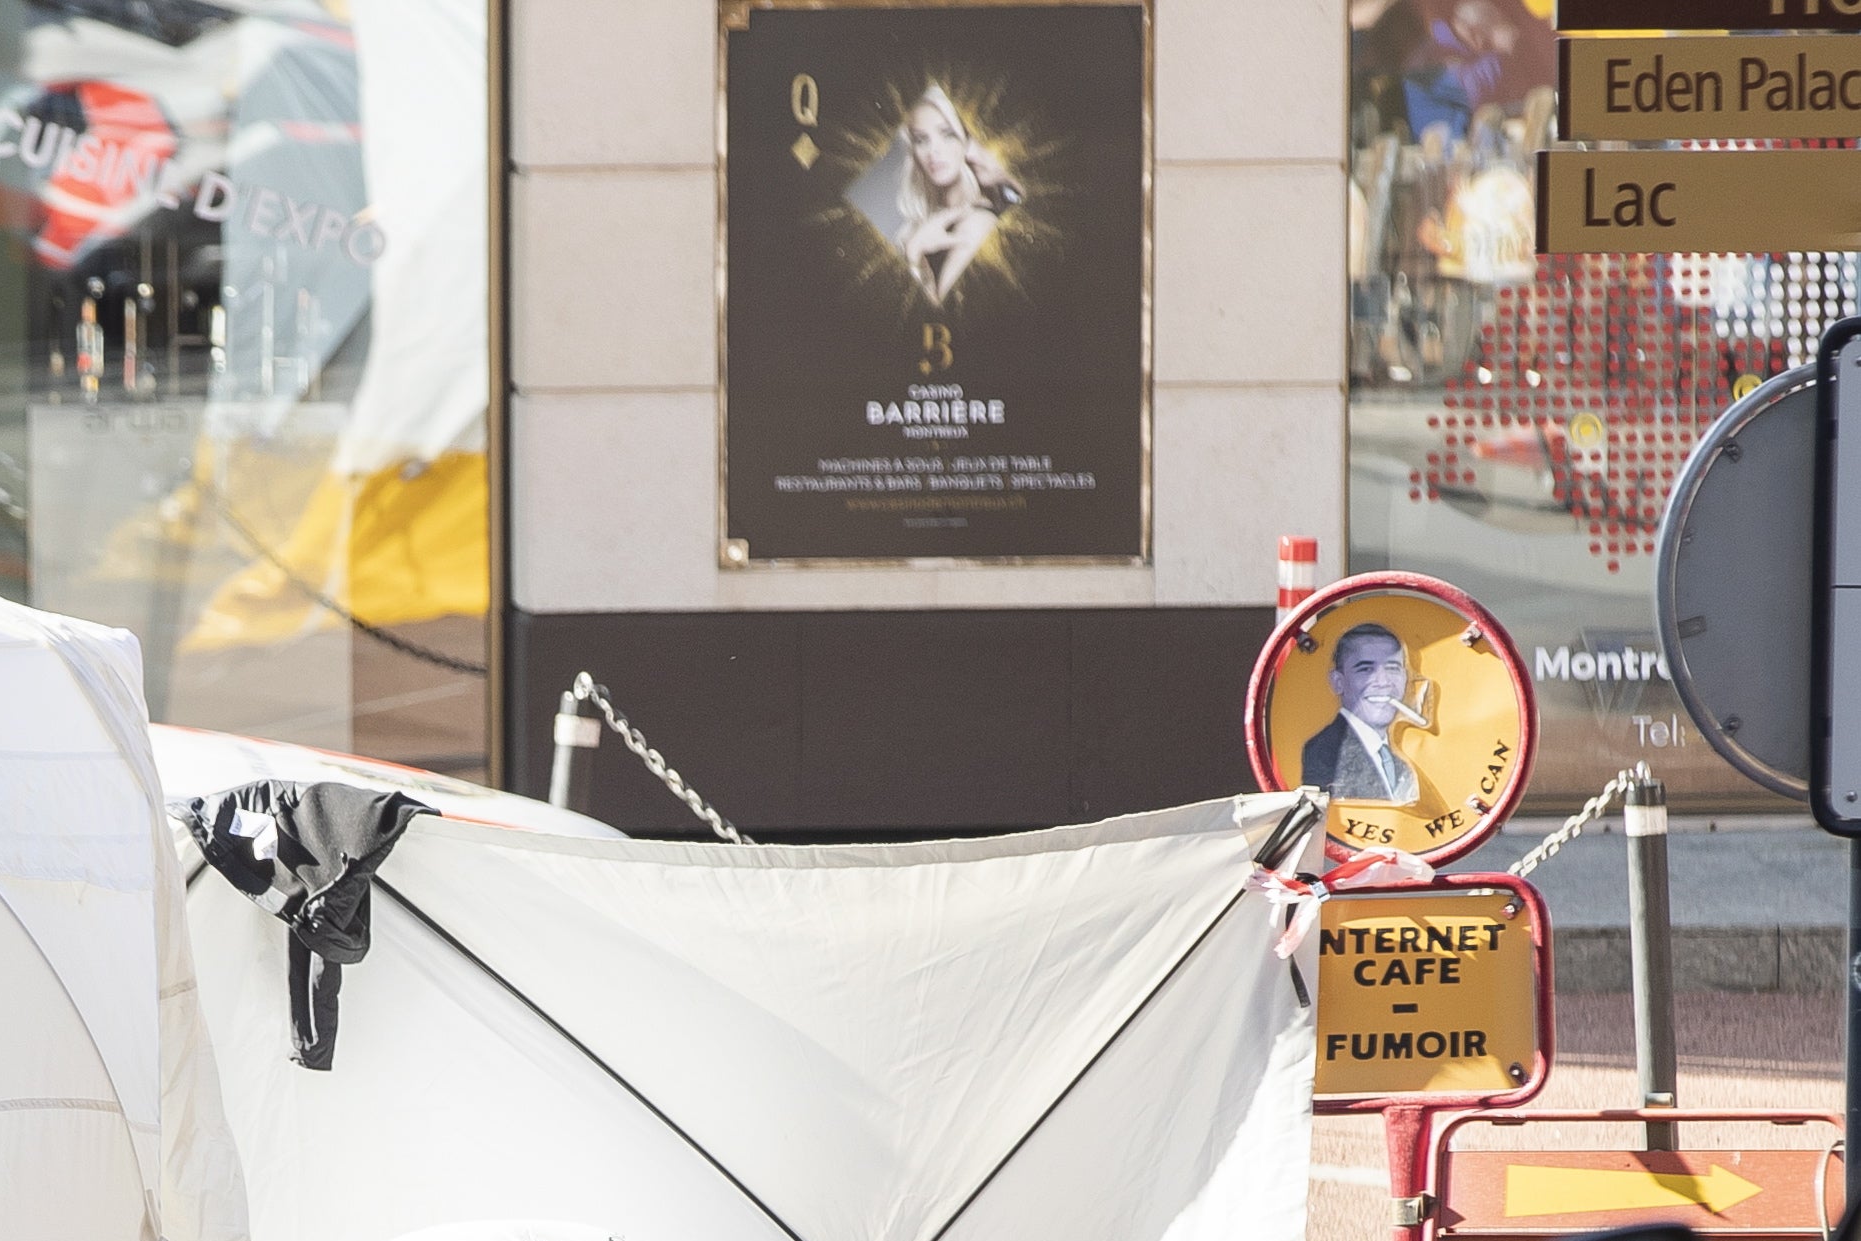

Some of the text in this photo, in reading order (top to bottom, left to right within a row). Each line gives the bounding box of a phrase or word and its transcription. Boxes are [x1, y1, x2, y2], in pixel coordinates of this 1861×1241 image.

[790, 73, 820, 127] Q
[1606, 52, 1861, 113] Eden Palac
[1584, 167, 1677, 228] Lac
[865, 398, 1006, 425] BARRIÈRE
[1345, 738, 1512, 844] YES WE CAN
[1319, 923, 1506, 955] NTERNET
[1353, 957, 1461, 987] CAFE
[1325, 1029, 1488, 1061] FUMOIR
